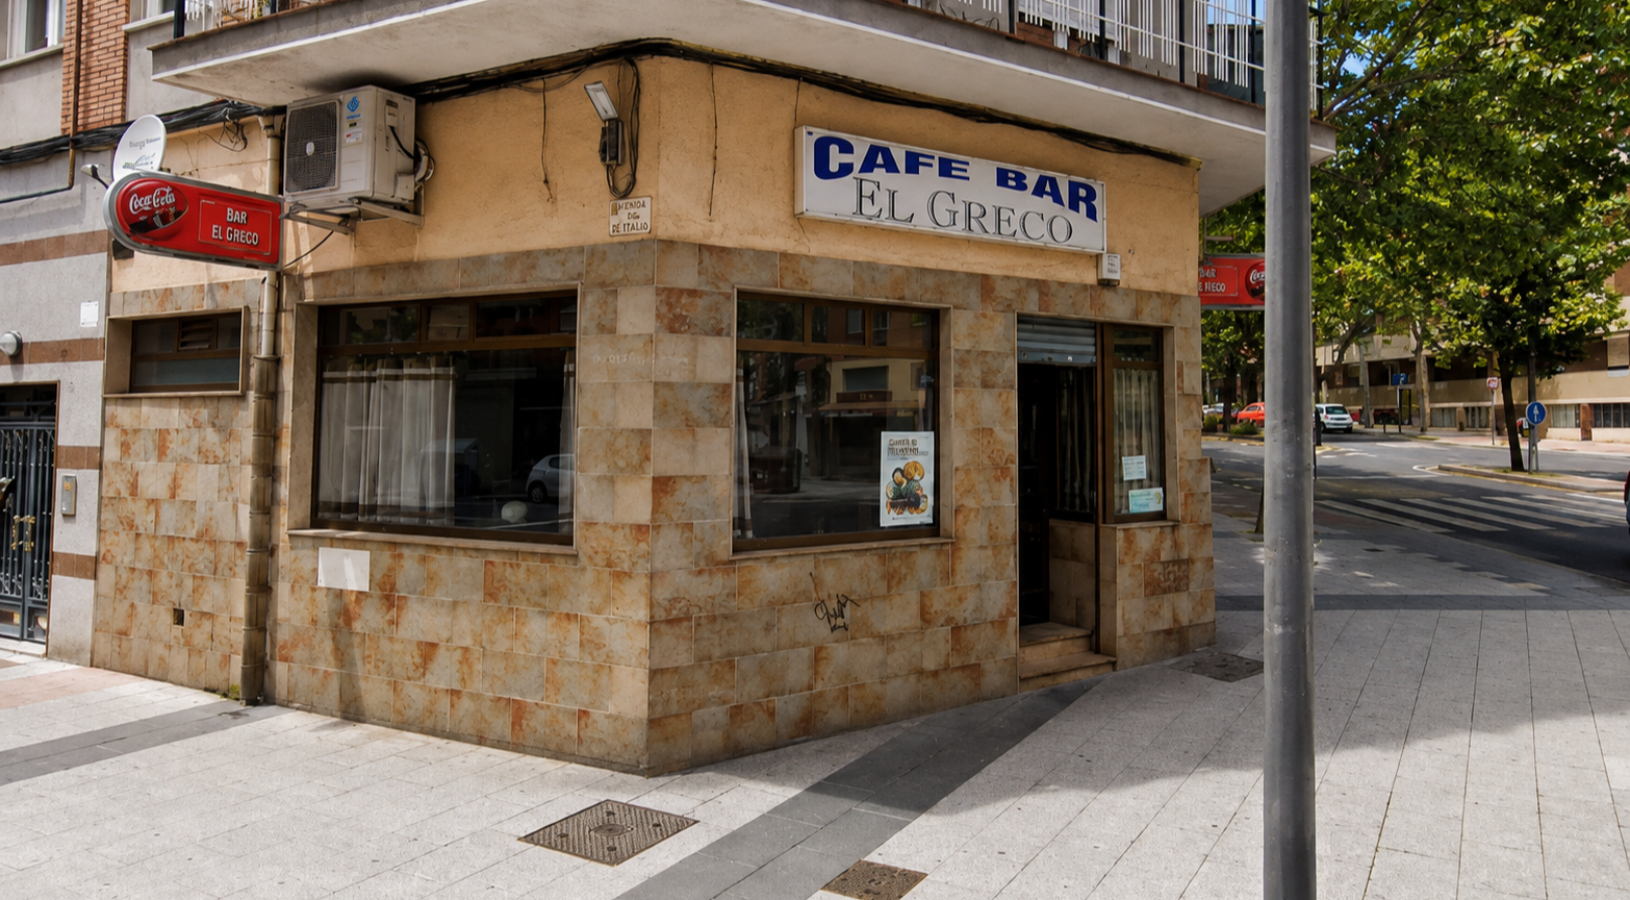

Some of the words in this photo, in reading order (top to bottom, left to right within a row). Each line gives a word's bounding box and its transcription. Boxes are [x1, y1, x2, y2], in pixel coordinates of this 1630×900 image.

[813, 135, 970, 181] CAFE
[996, 167, 1098, 223] BAR
[226, 207, 247, 224] BAR
[852, 176, 915, 223] EL
[926, 190, 1073, 244] GRECO
[211, 224, 223, 240] EL
[226, 226, 259, 246] GRECO
